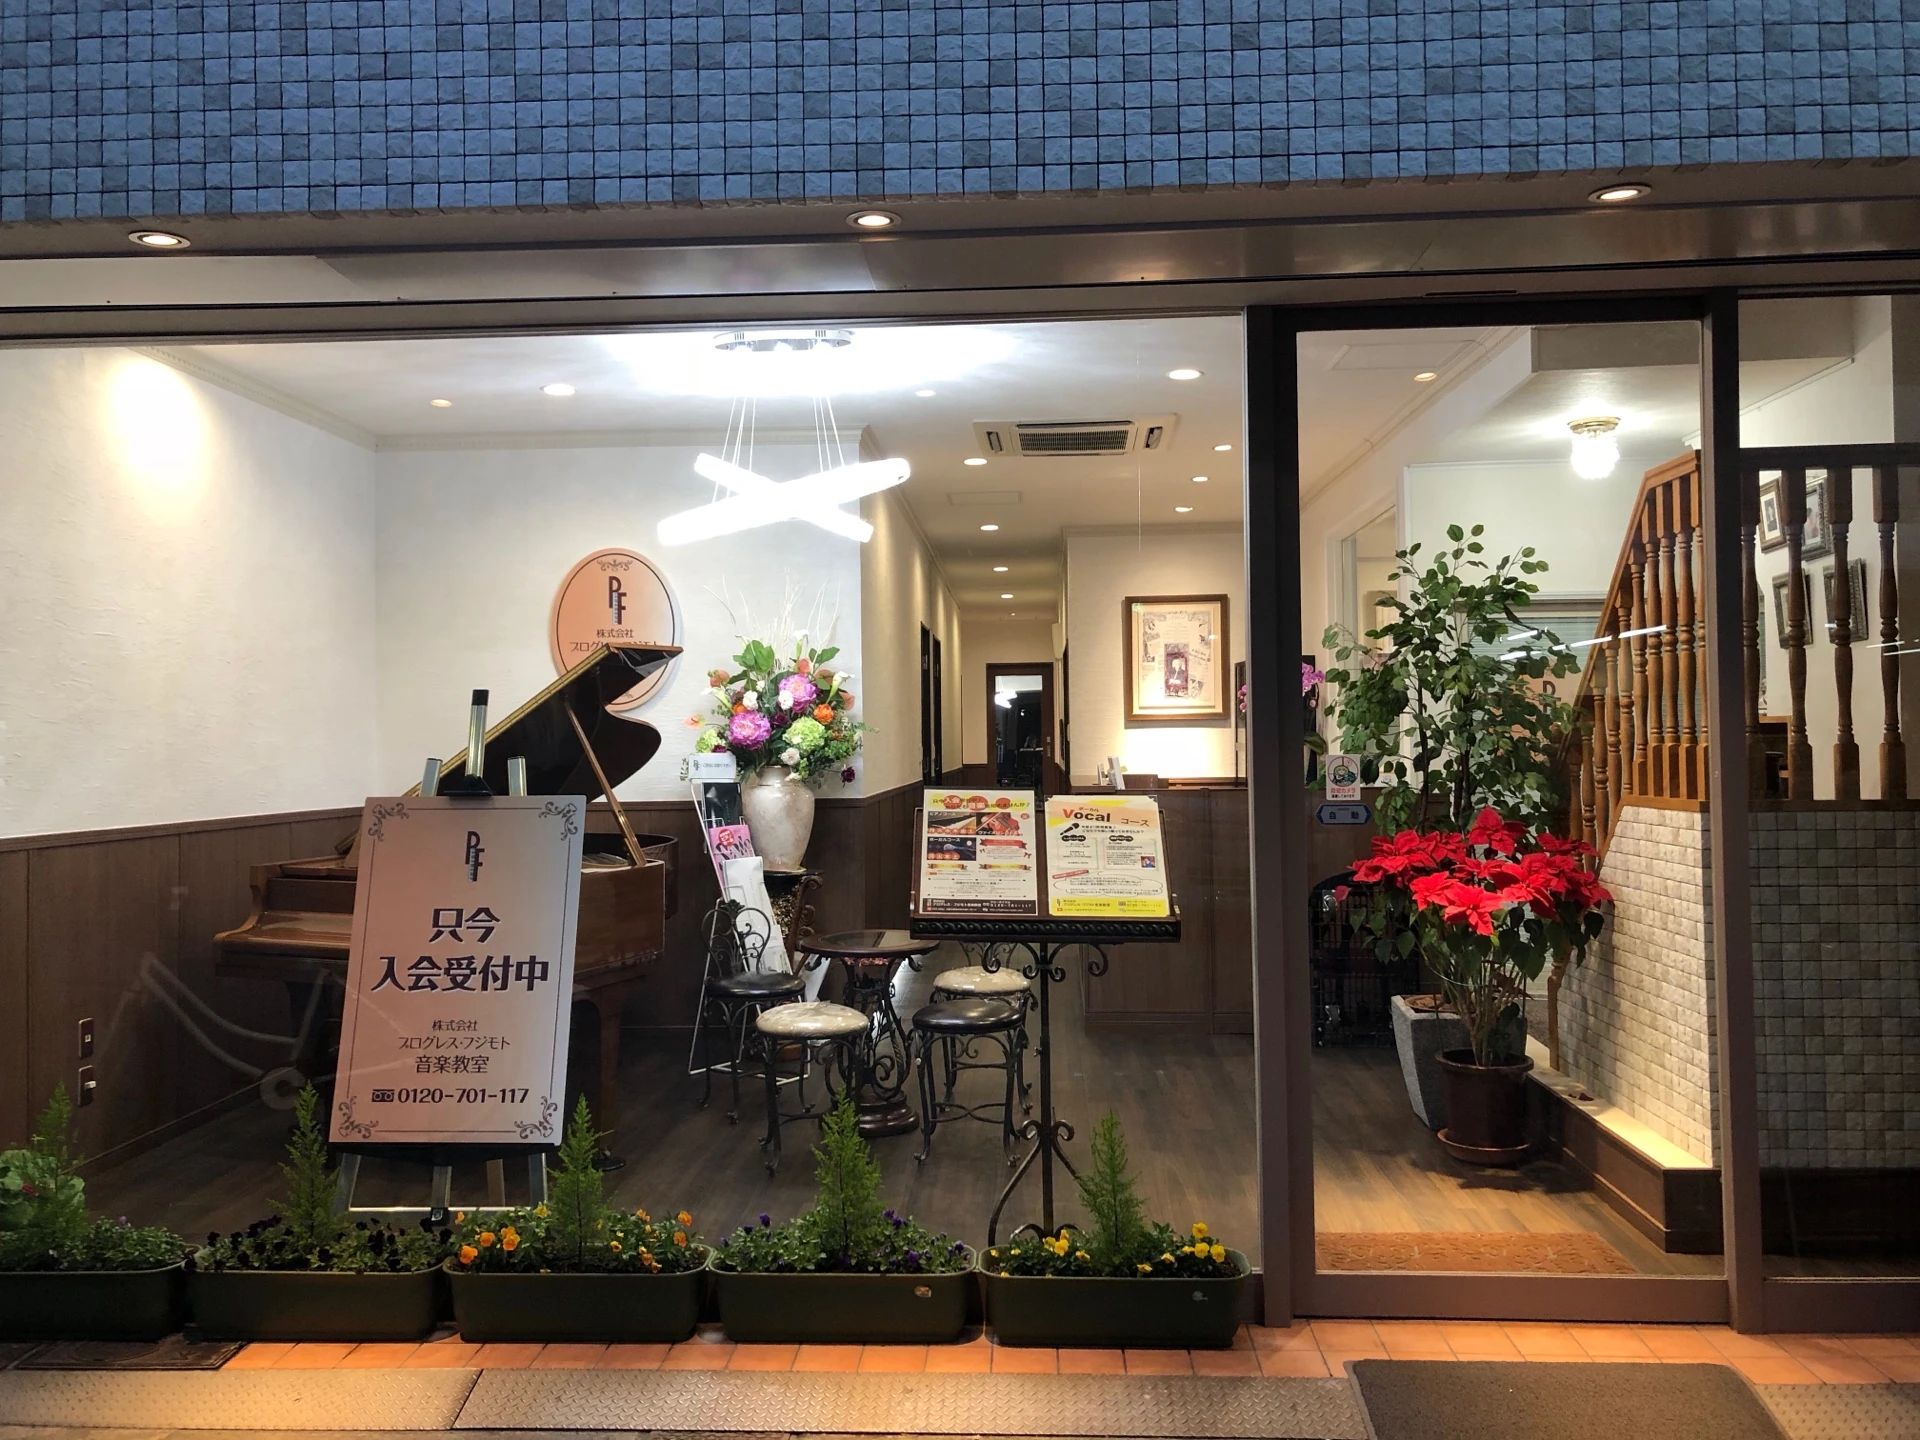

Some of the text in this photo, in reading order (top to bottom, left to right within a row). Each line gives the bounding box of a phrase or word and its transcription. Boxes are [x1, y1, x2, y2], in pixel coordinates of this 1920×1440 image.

[596, 628, 634, 638] 株式会社
[1062, 808, 1111, 822] Vocal
[1120, 817, 1150, 827] コース
[429, 907, 501, 943] 只今
[370, 955, 549, 992] 入会受付中
[431, 1019, 478, 1032] 株式会社
[415, 1055, 490, 1074] 音楽教室
[397, 1088, 530, 1104] 0120-701-117
